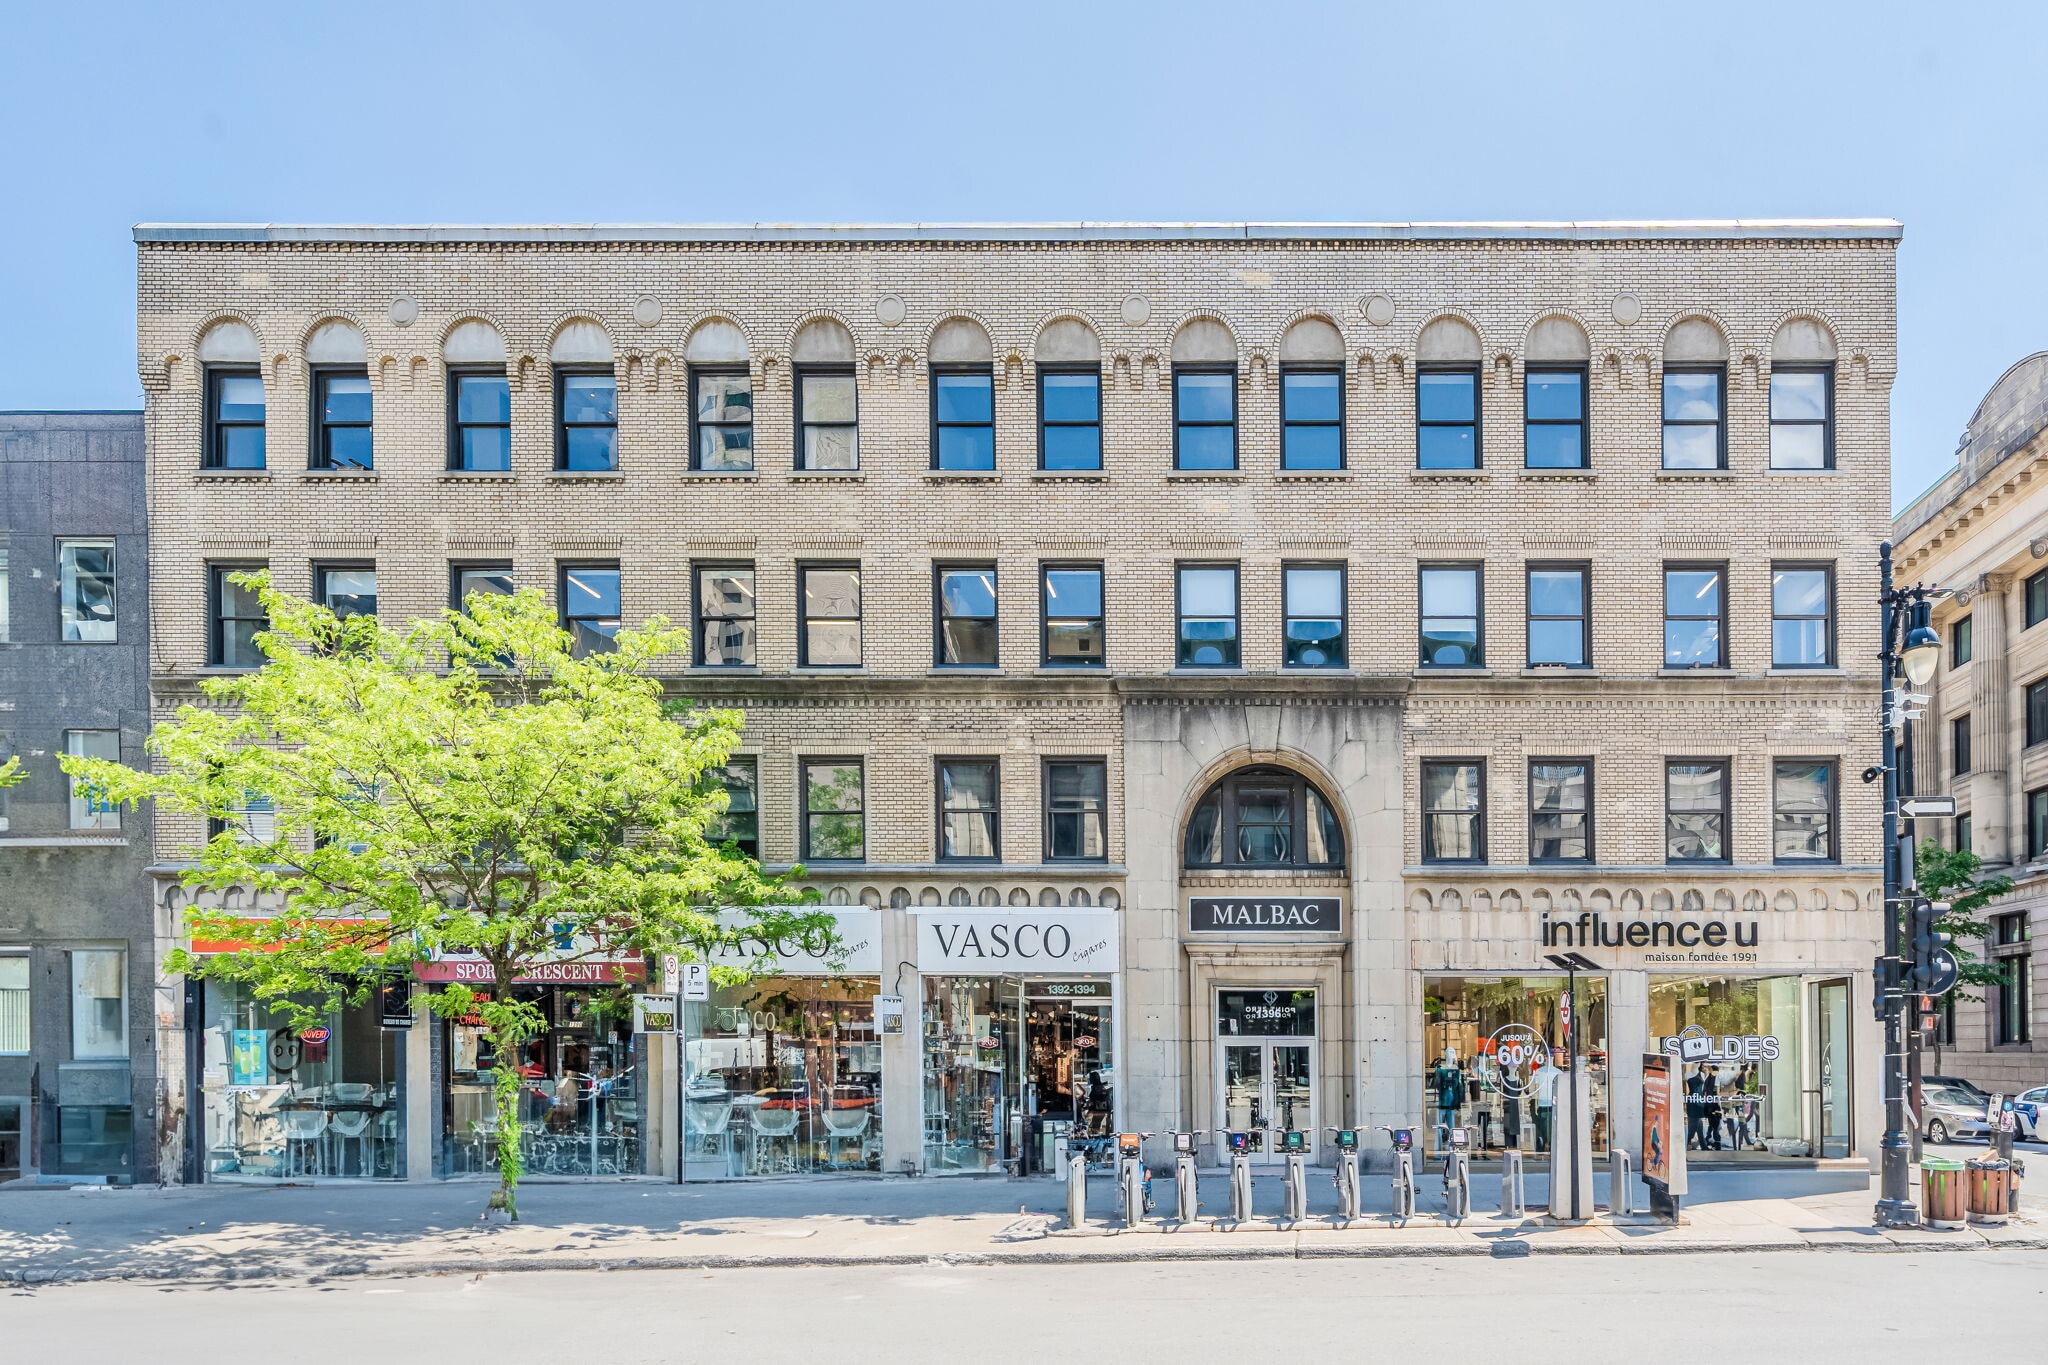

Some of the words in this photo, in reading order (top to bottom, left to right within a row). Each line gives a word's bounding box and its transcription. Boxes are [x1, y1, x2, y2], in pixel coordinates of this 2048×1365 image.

[1212, 904, 1320, 925] MALBAC
[1542, 912, 1727, 948] influence
[1735, 921, 1759, 948] u
[931, 923, 1072, 959] VASCO
[1072, 937, 1107, 964] Cigares
[1645, 952, 1685, 962] maison
[1688, 951, 1728, 962] fondée
[1732, 952, 1758, 962] 1991
[522, 964, 603, 980] CRESCENT
[690, 966, 700, 979] P
[1047, 984, 1096, 995] 1392-1394
[1256, 1009, 1282, 1019] 1396
[1664, 1029, 1780, 1063] SLDES
